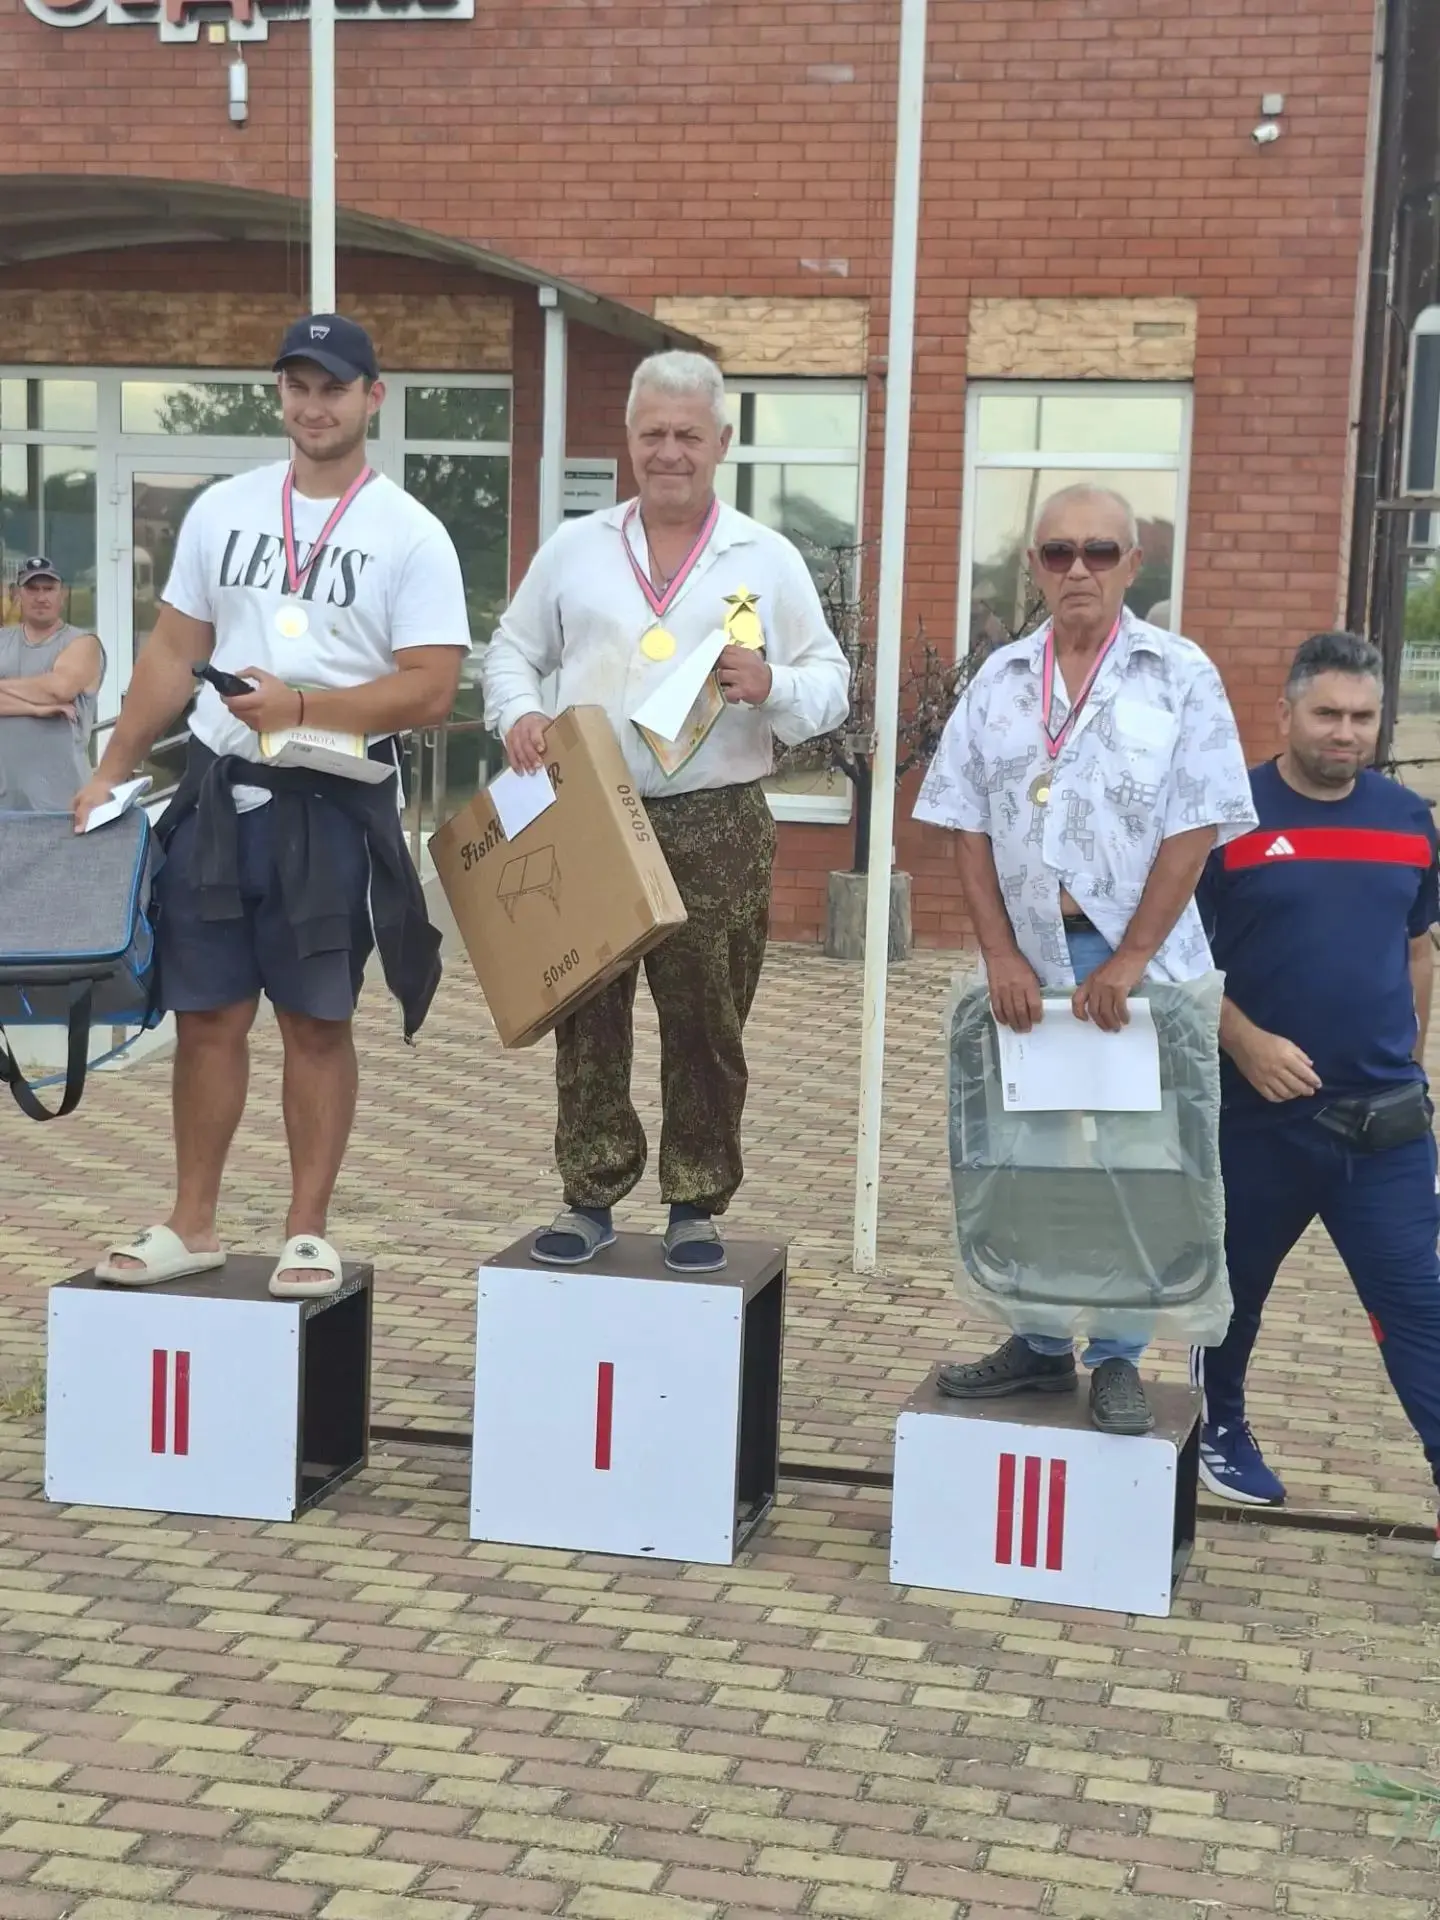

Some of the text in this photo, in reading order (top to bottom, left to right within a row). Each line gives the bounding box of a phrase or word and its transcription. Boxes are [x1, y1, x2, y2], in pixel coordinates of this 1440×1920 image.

[219, 529, 369, 608] LEVI'S
[617, 784, 651, 843] 50x80
[543, 948, 580, 988] 50x80
